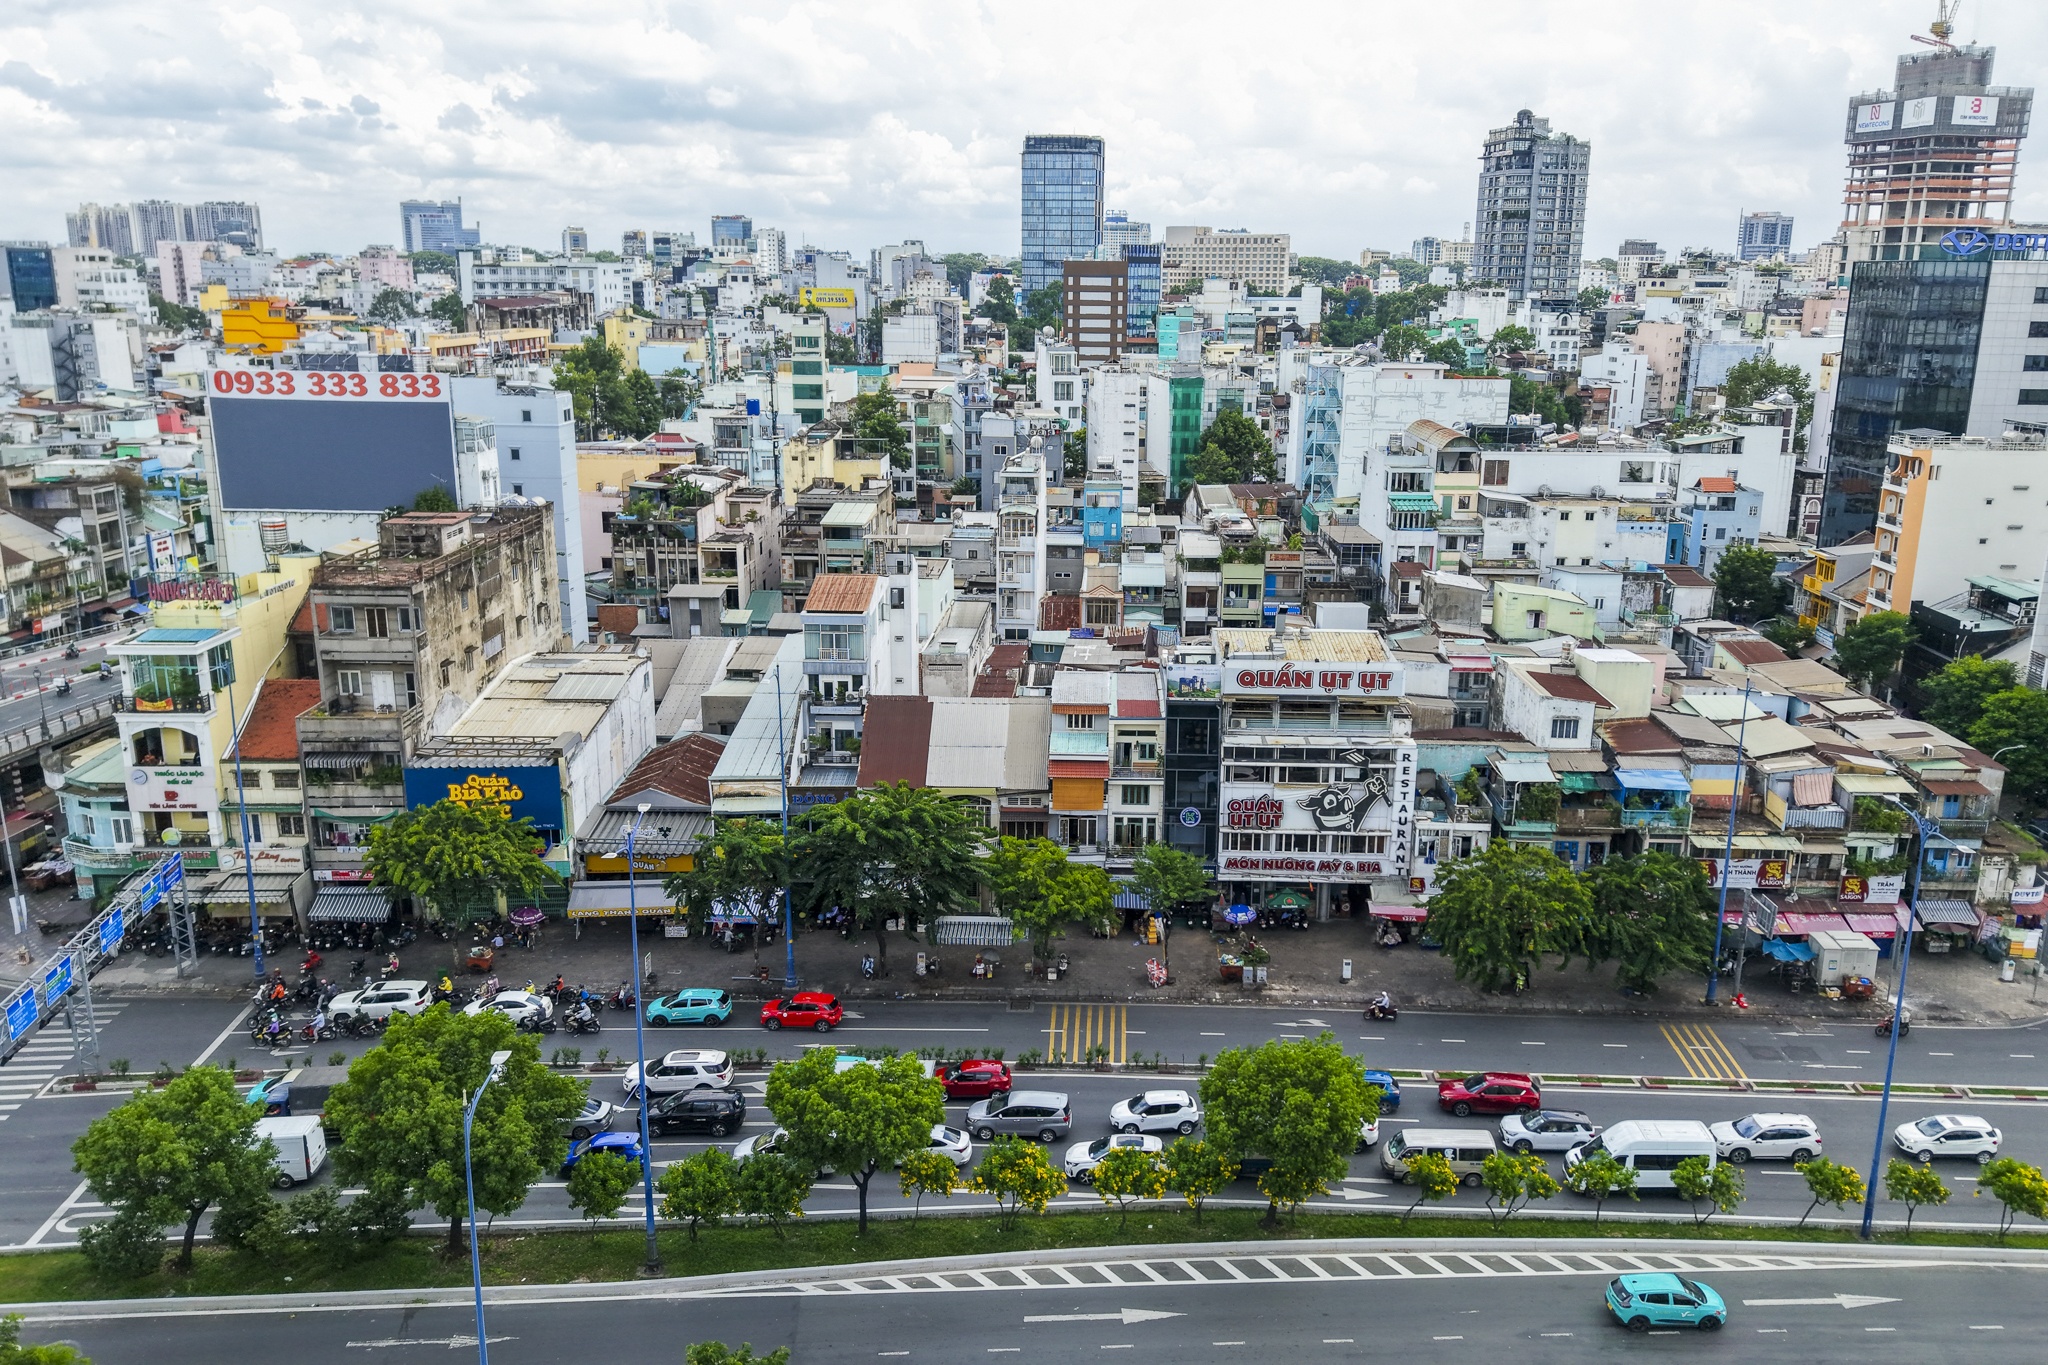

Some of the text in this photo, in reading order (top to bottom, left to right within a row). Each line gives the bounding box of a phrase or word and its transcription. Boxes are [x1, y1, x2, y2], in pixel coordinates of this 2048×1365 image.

[1858, 120, 1890, 128] NEWTECONS
[214, 370, 442, 398] 0933 333 833
[1237, 662, 1393, 694] QUÁN ỤT ỤT
[467, 773, 510, 790] Quán
[448, 784, 523, 802] Bia Khô
[792, 792, 837, 804] ĐÔNG
[1228, 812, 1284, 830] ỤT ỤT
[1395, 753, 1412, 876] RESTAURANT
[1224, 856, 1382, 873] MÓN NƯỚNG MỸ & BIA
